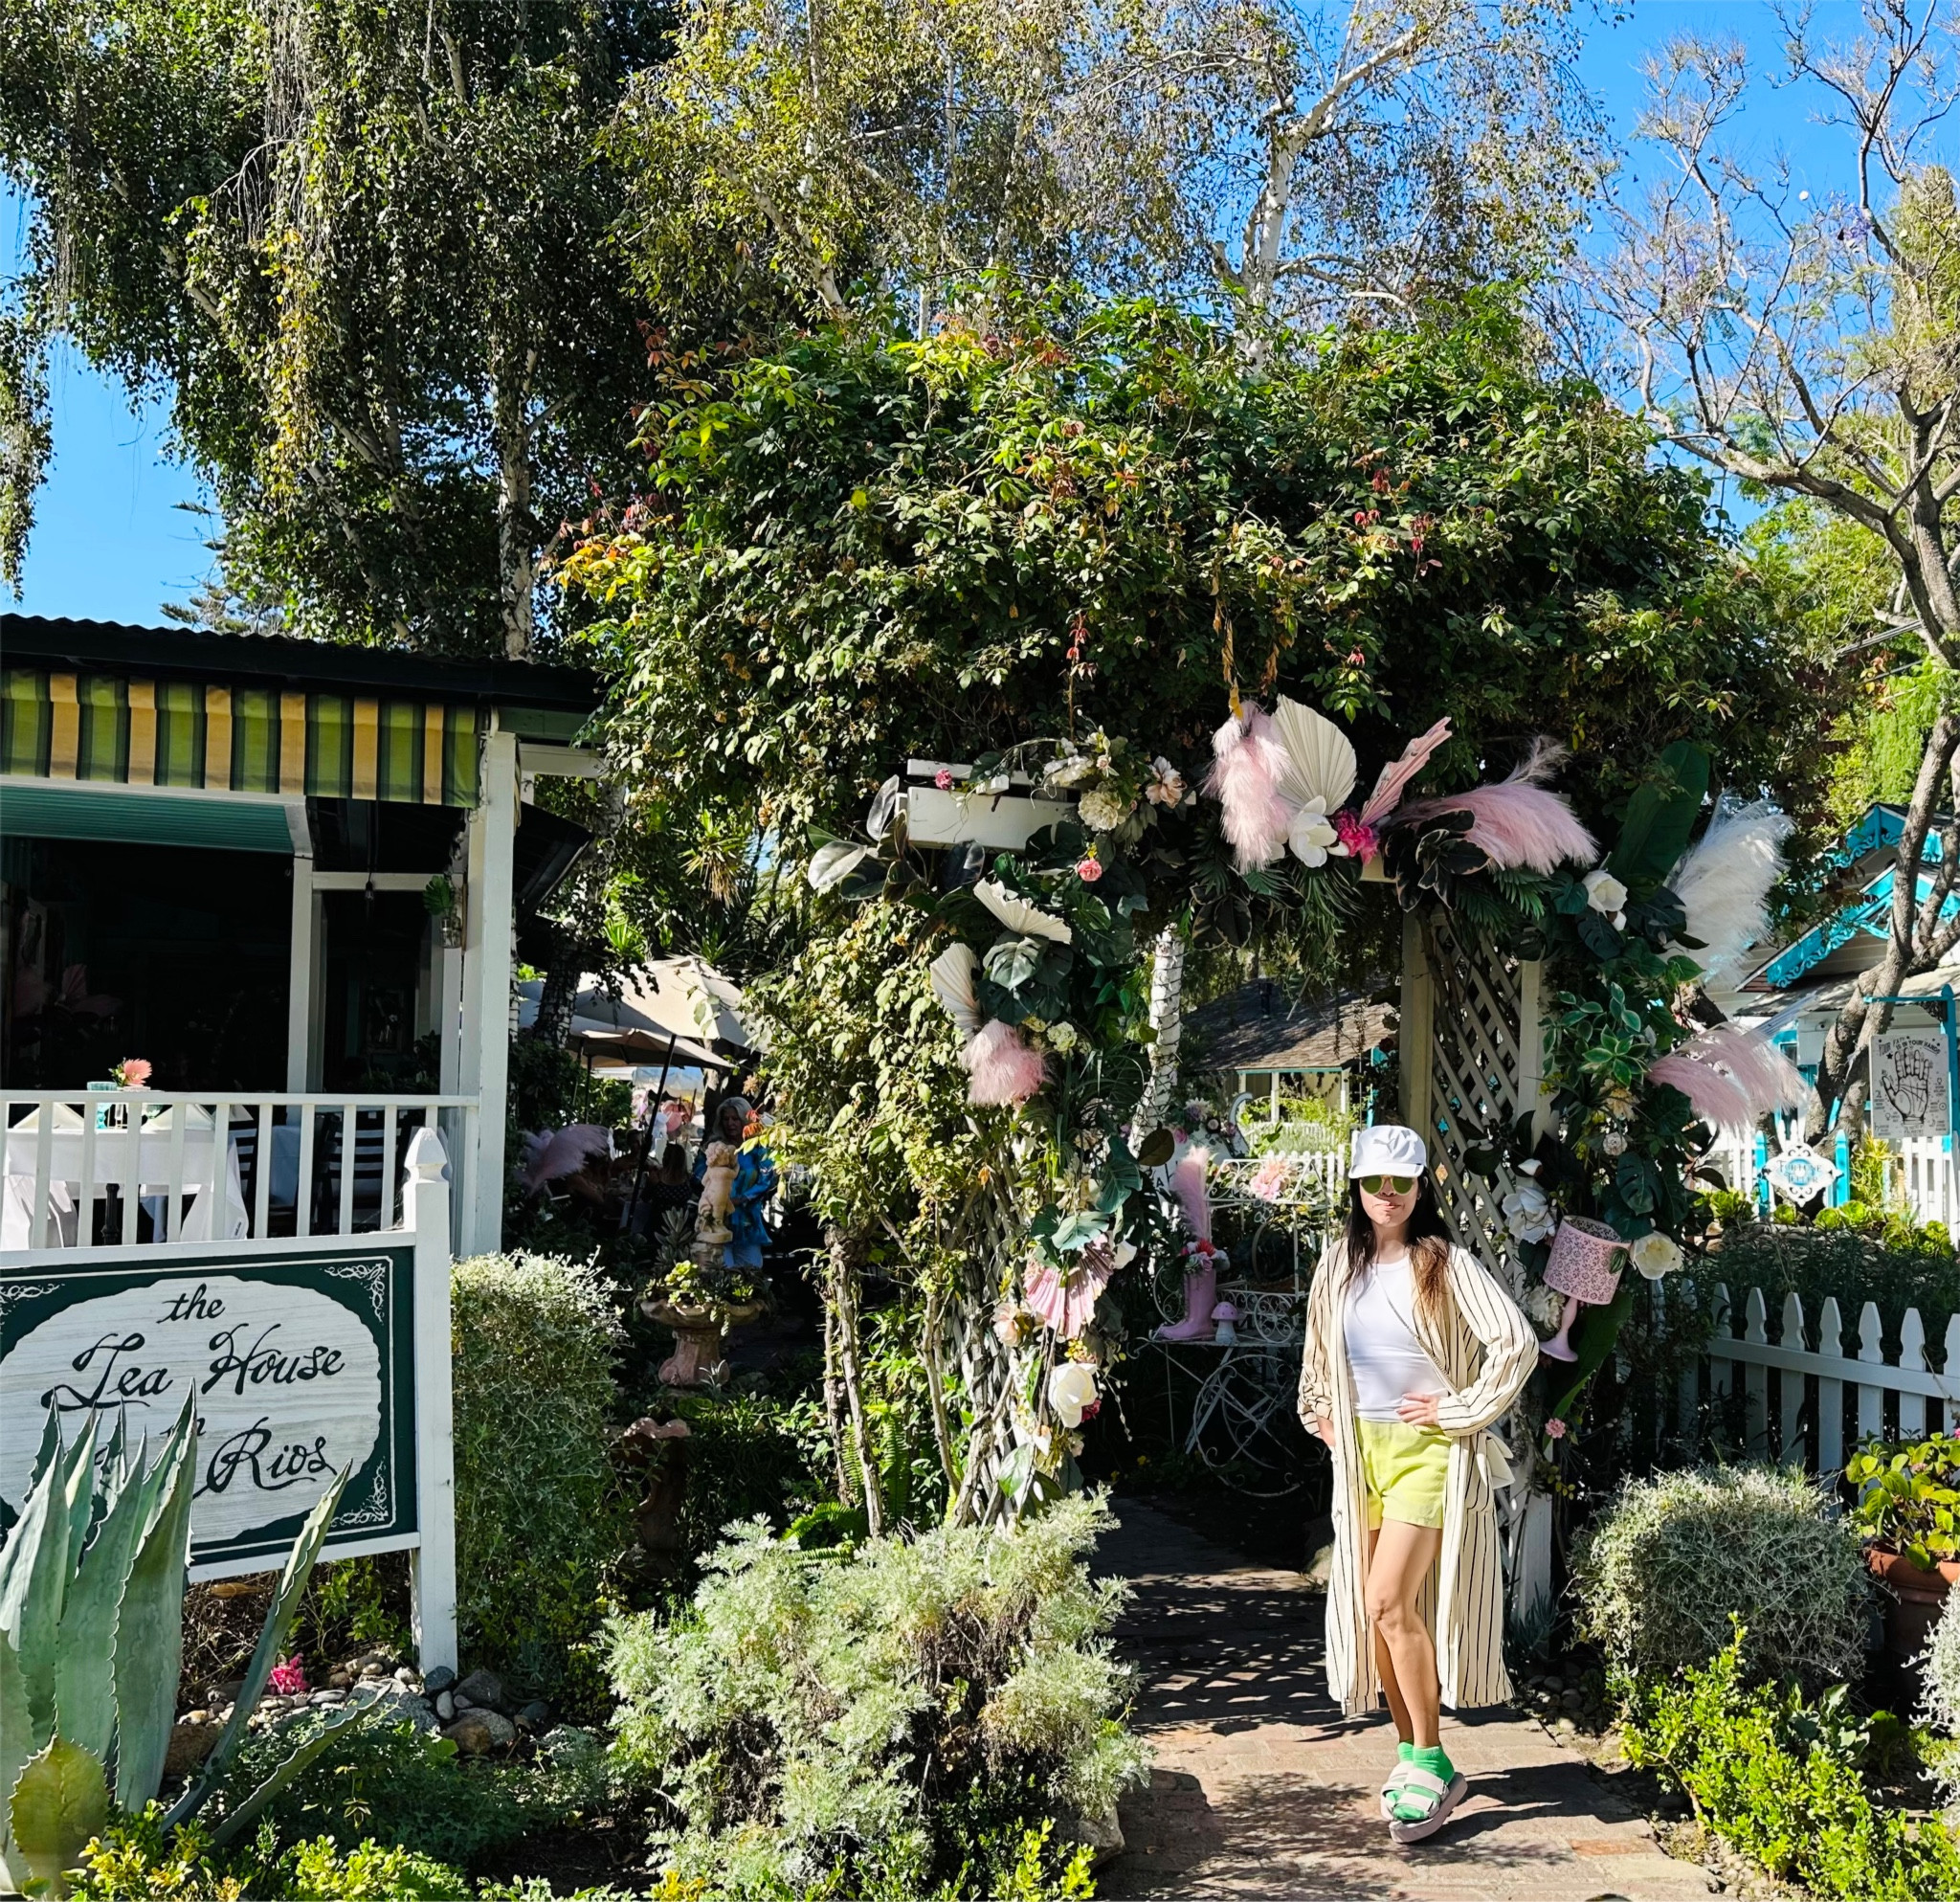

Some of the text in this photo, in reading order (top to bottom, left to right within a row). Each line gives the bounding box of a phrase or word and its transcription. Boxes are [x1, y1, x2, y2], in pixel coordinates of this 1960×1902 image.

[156, 1283, 226, 1324] the
[40, 1323, 345, 1411] Tea House
[192, 1417, 338, 1500] Rios
